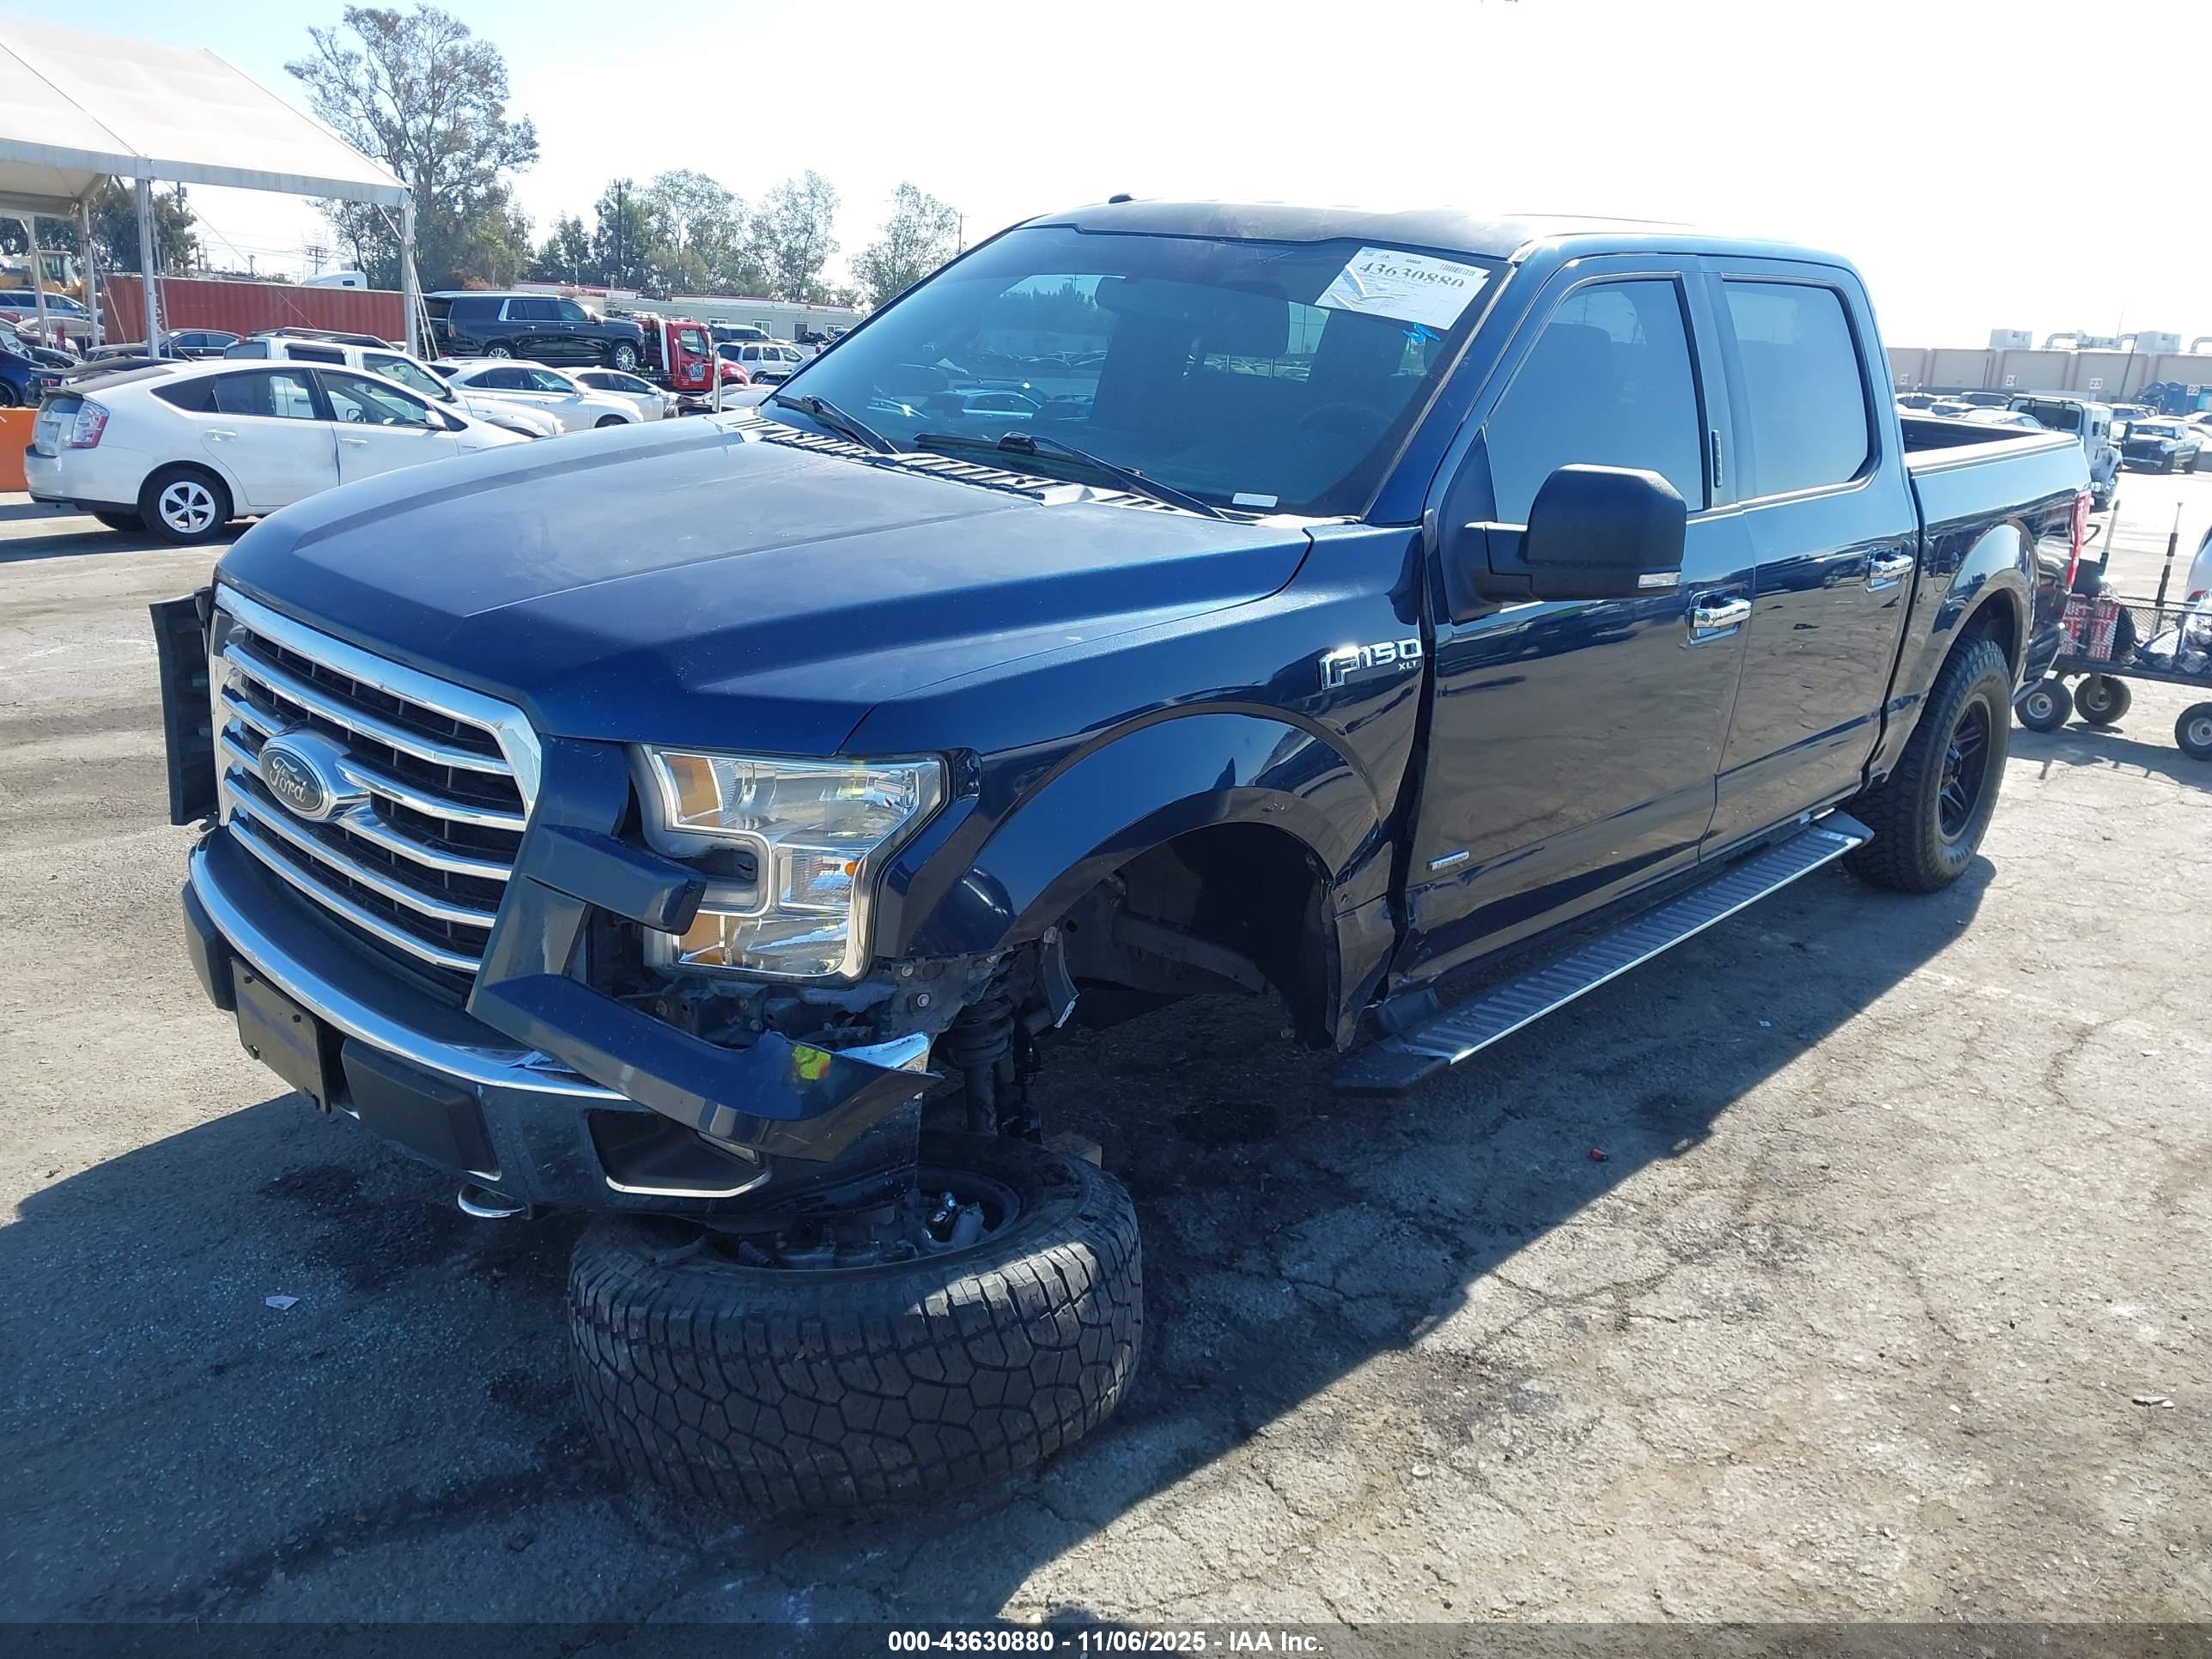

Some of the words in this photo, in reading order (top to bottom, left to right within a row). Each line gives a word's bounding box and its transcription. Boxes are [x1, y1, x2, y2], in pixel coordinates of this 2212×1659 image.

[1358, 262, 1465, 289] 43630880
[1398, 659, 1418, 671] XLT
[269, 757, 307, 803] Ford
